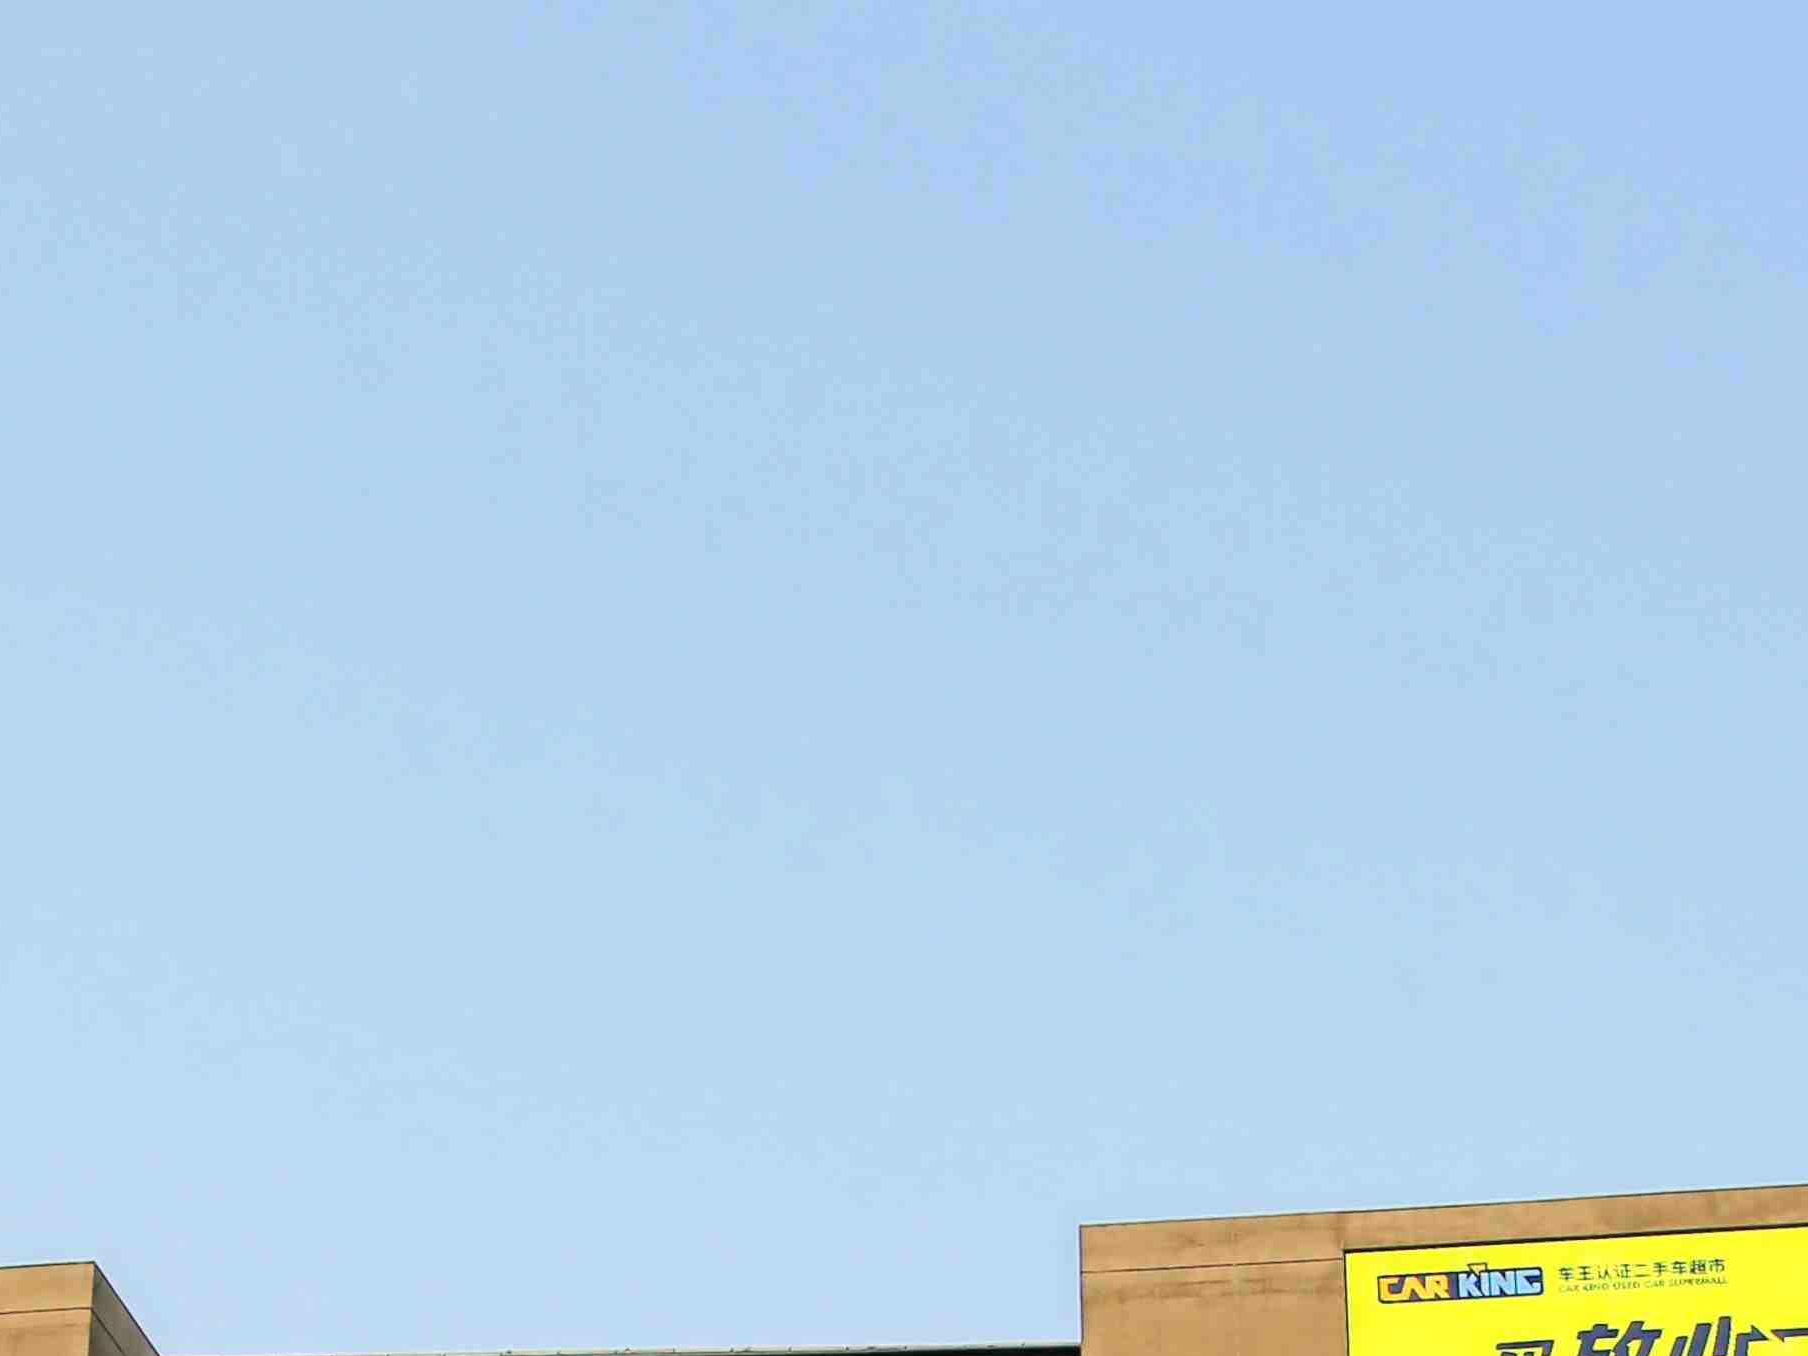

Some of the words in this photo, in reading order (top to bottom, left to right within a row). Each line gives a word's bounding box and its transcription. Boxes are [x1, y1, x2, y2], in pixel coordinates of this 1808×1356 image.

[1378, 1274, 1451, 1303] CAR
[1456, 1263, 1543, 1298] KING
[1558, 1258, 1726, 1281] 车王认证二手车超市
